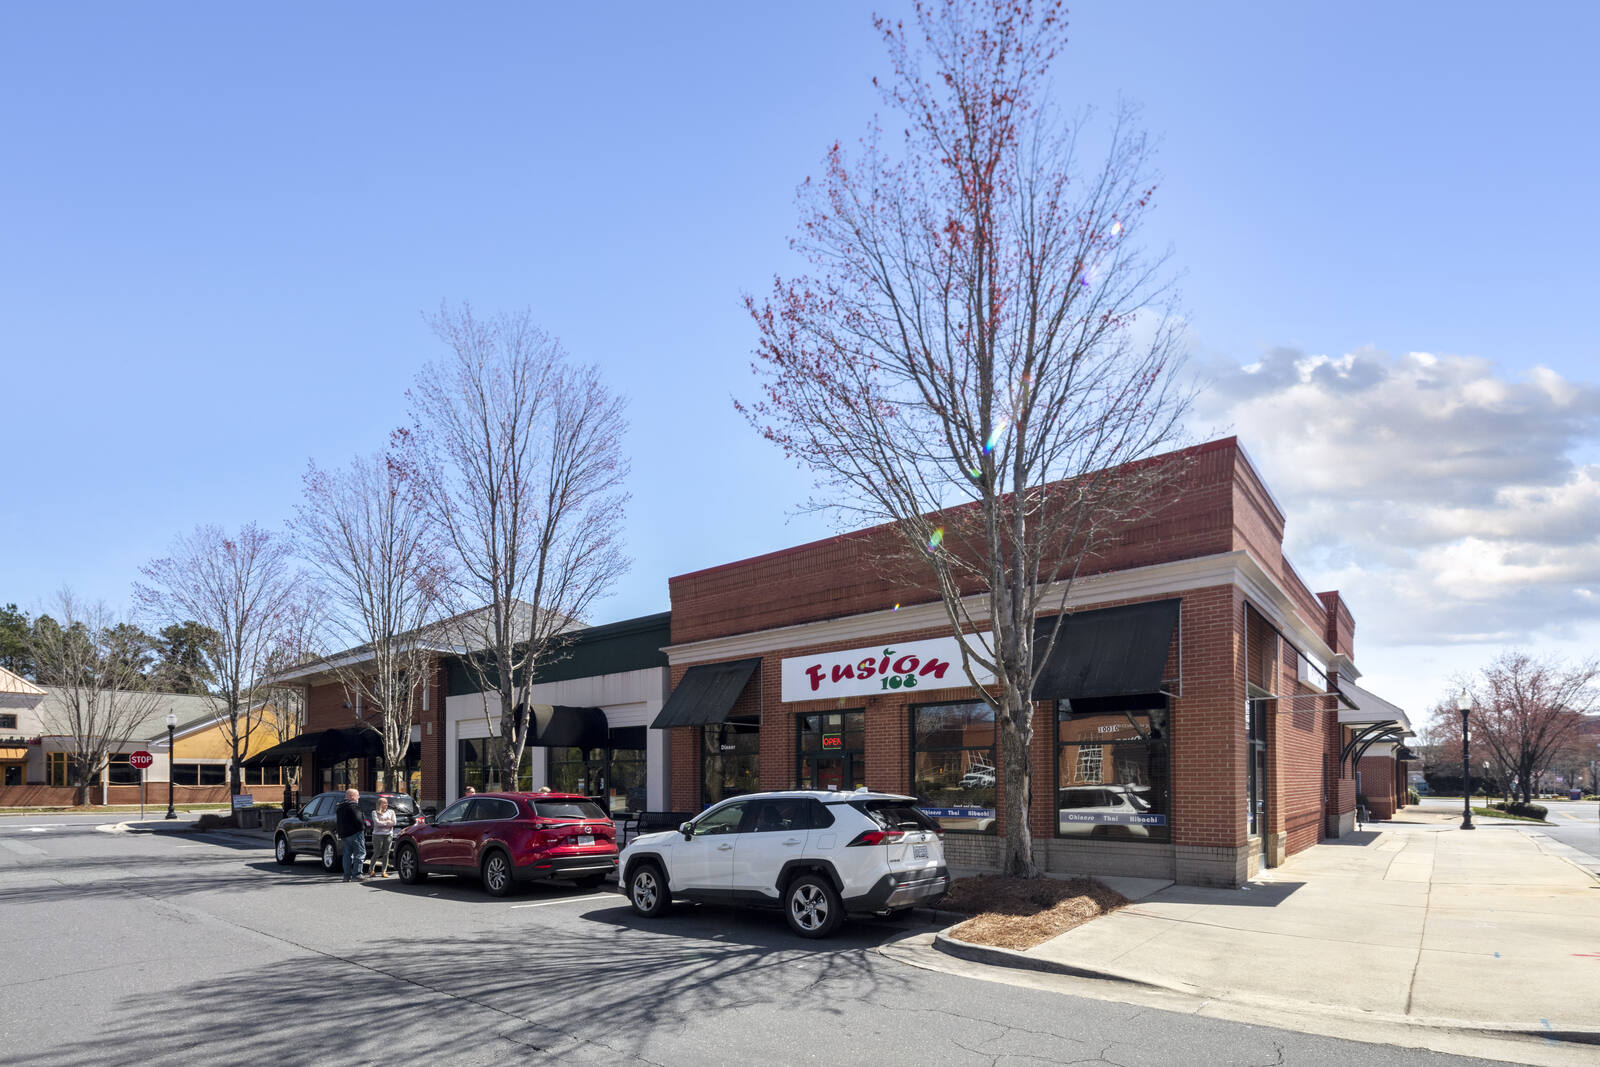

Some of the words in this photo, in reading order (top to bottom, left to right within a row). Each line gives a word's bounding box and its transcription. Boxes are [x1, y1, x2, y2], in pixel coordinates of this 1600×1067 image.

[805, 648, 950, 691] Fusion
[880, 674, 917, 690] 108
[1129, 815, 1158, 823] Hibachi
